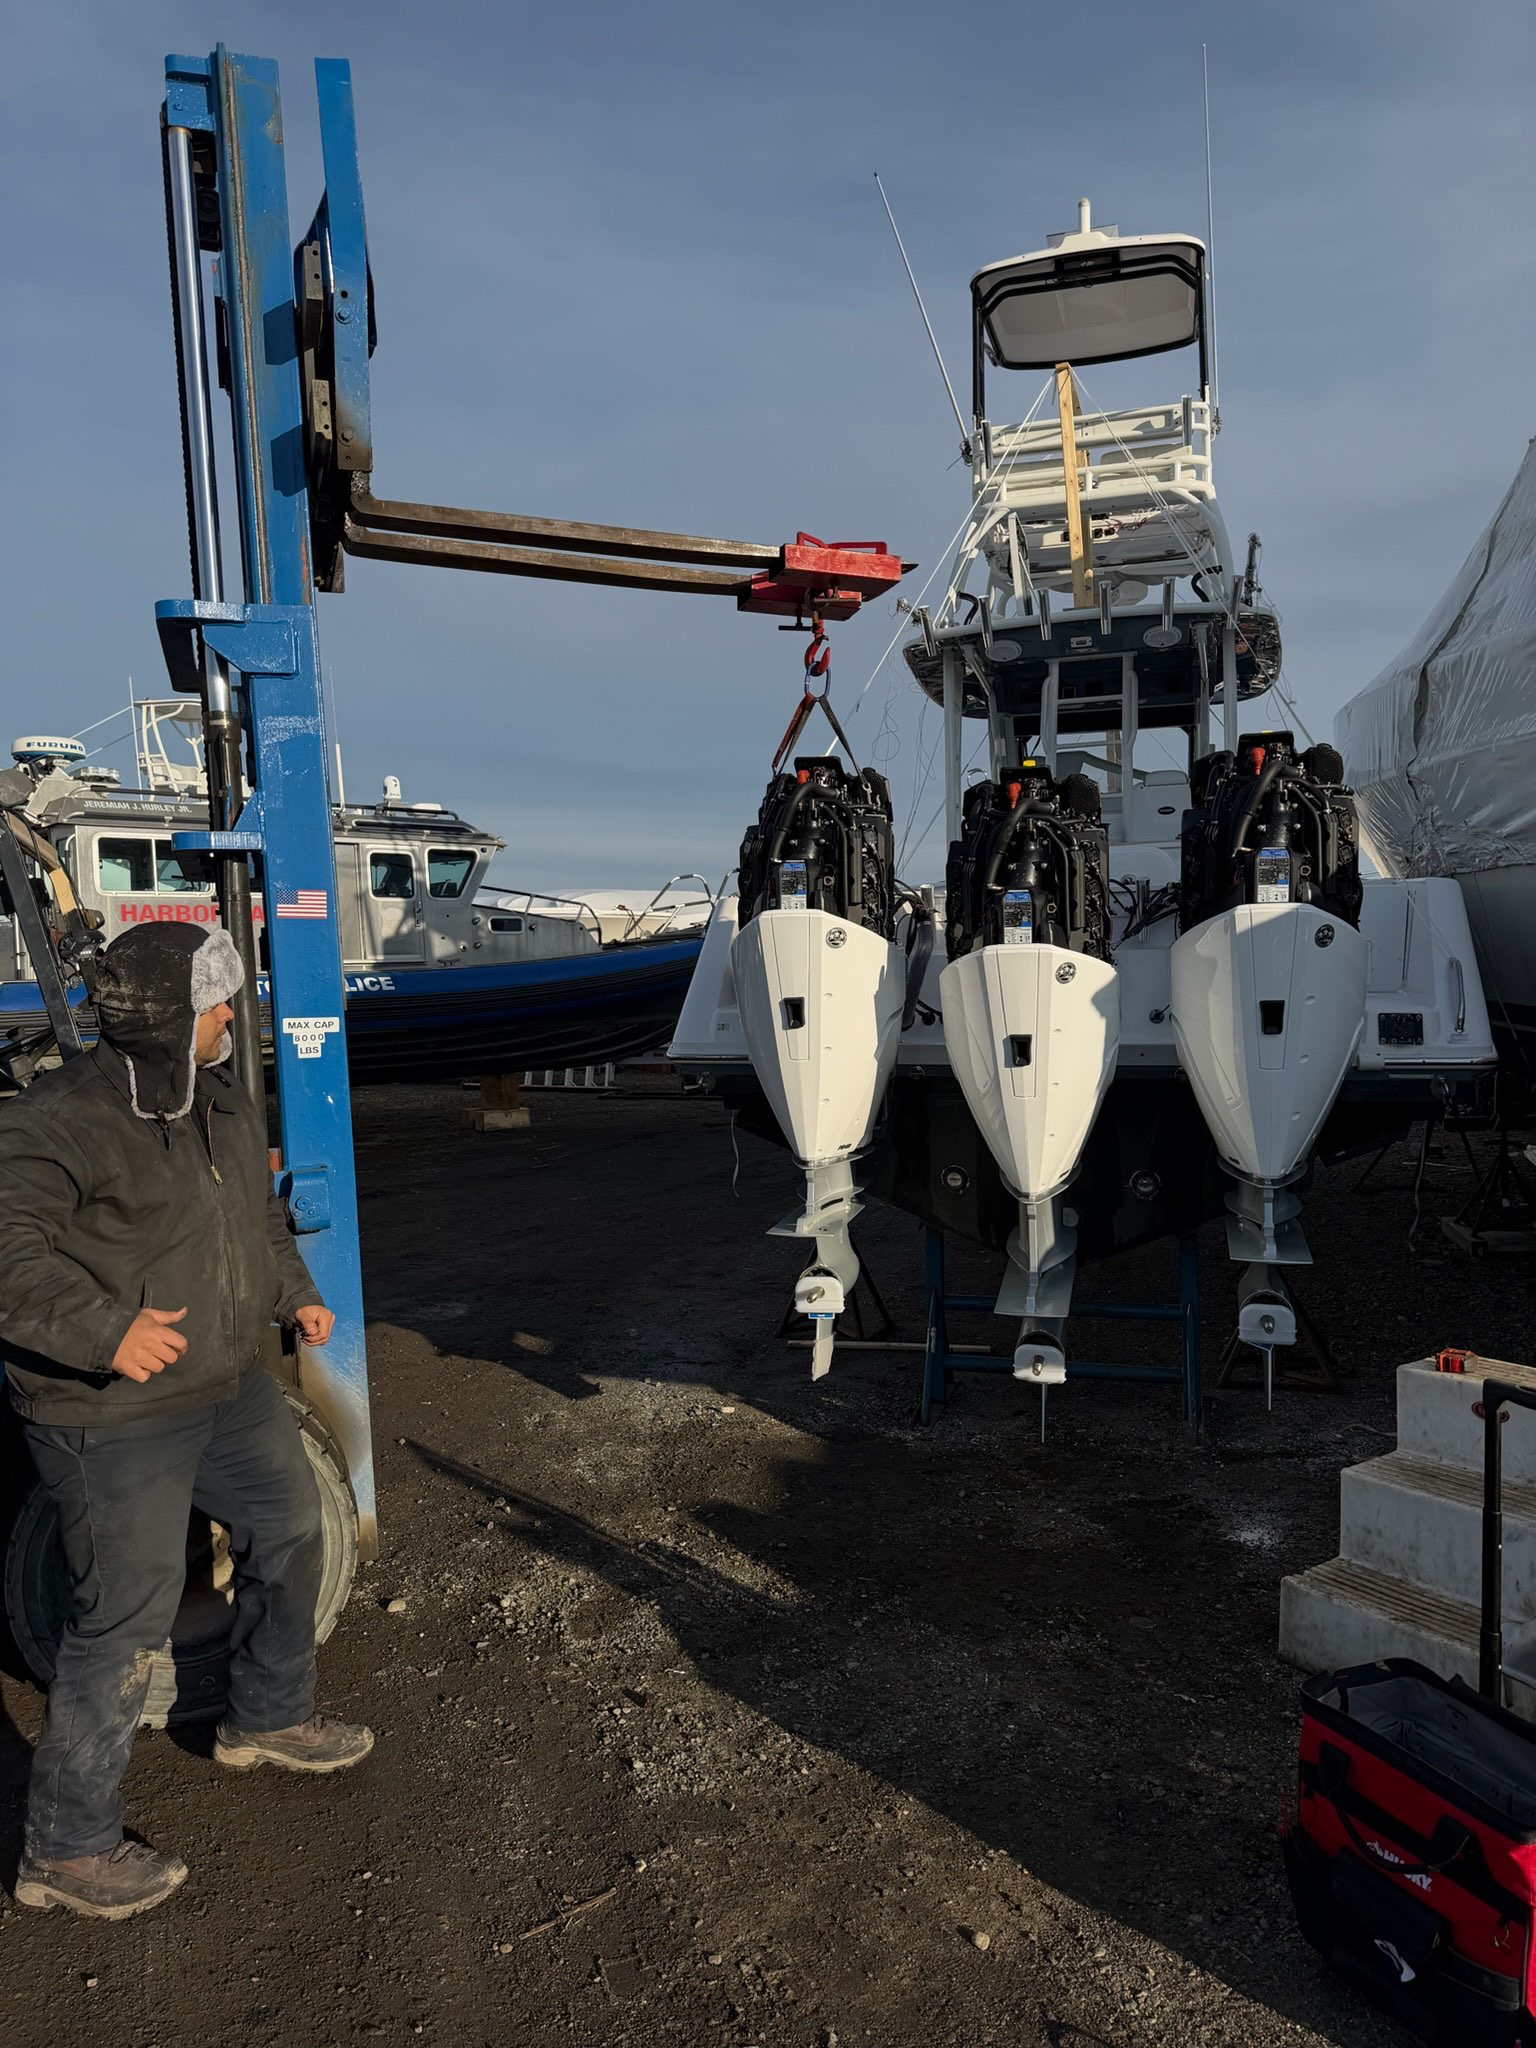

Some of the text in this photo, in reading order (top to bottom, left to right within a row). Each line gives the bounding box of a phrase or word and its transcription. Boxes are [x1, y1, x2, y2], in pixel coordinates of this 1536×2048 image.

[26, 741, 84, 752] FURUNO
[83, 800, 193, 814] JEREMIAH J. HURLEY JR.
[344, 976, 396, 992] LICE
[287, 1020, 334, 1030] MAX CAP
[294, 1033, 324, 1042] 8000
[299, 1046, 320, 1055] LBS
